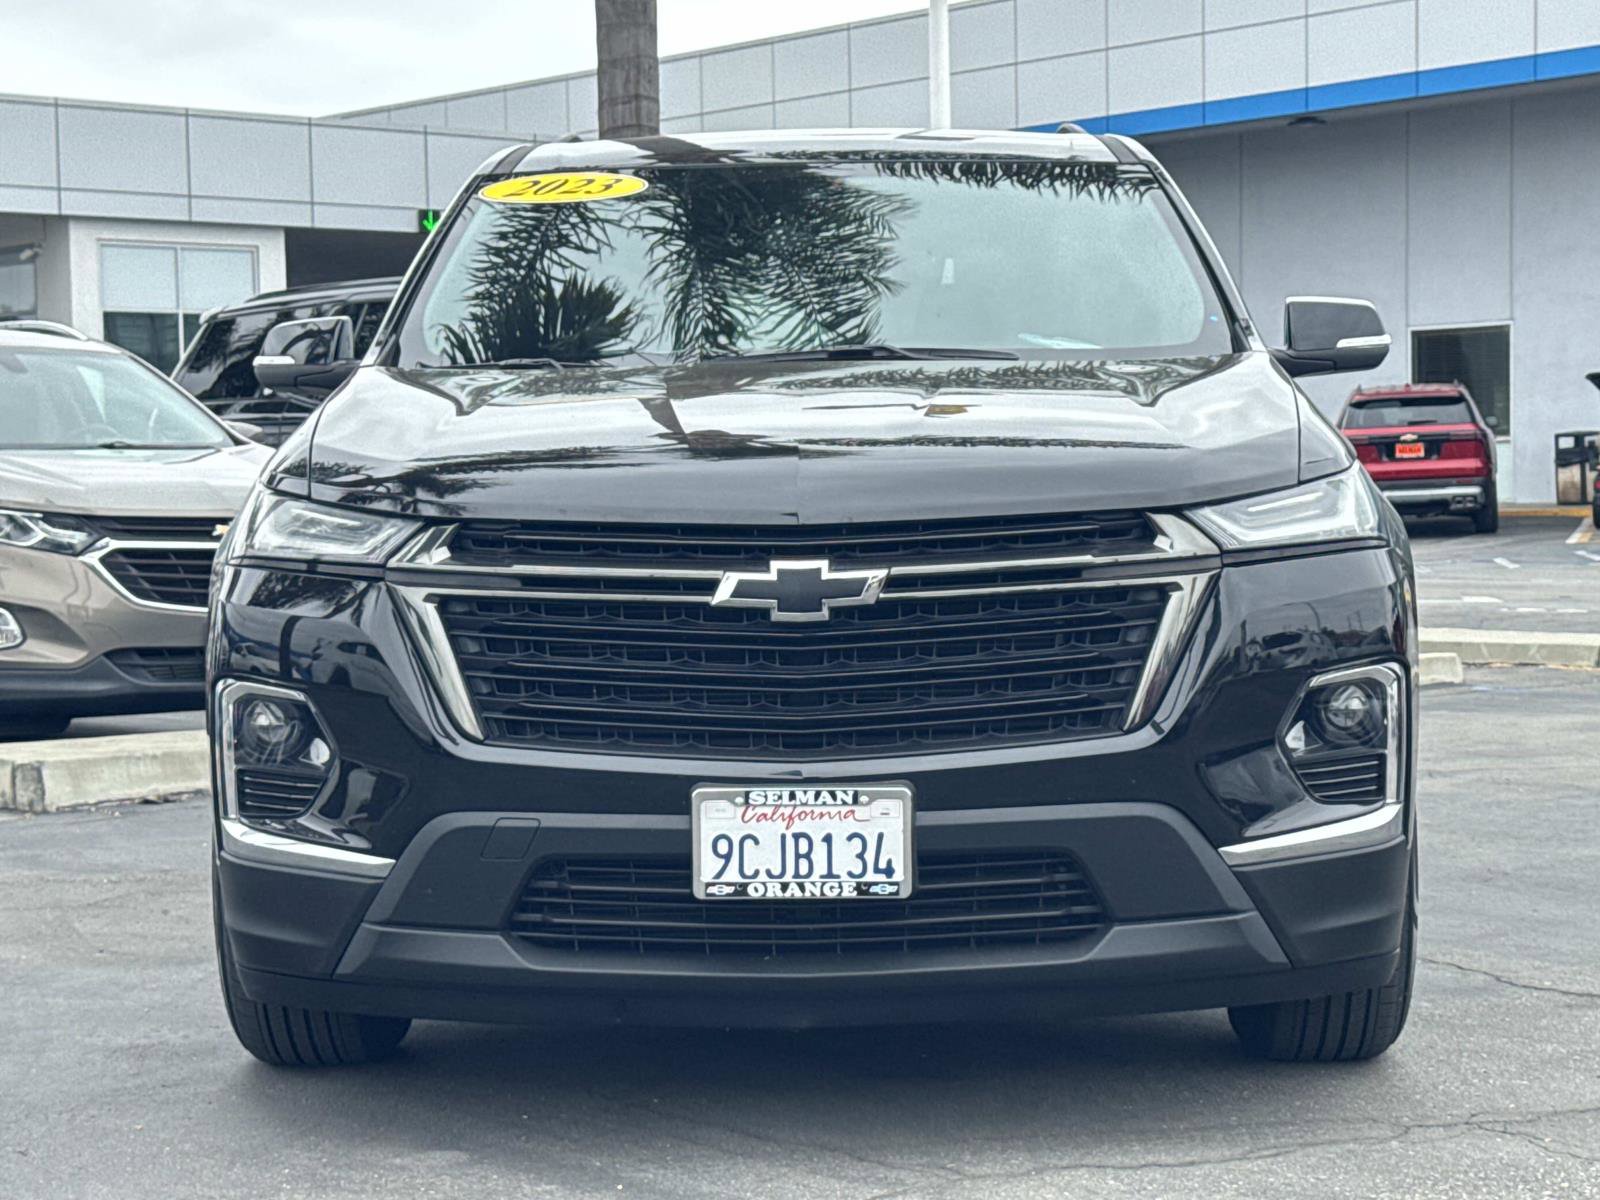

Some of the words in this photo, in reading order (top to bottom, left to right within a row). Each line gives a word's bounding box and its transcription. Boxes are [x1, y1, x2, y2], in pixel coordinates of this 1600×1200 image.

[502, 178, 622, 197] 2023
[748, 790, 855, 806] SELMAN
[741, 804, 871, 830] California
[711, 831, 896, 880] 9CJB134
[746, 881, 858, 898] ORANGE
